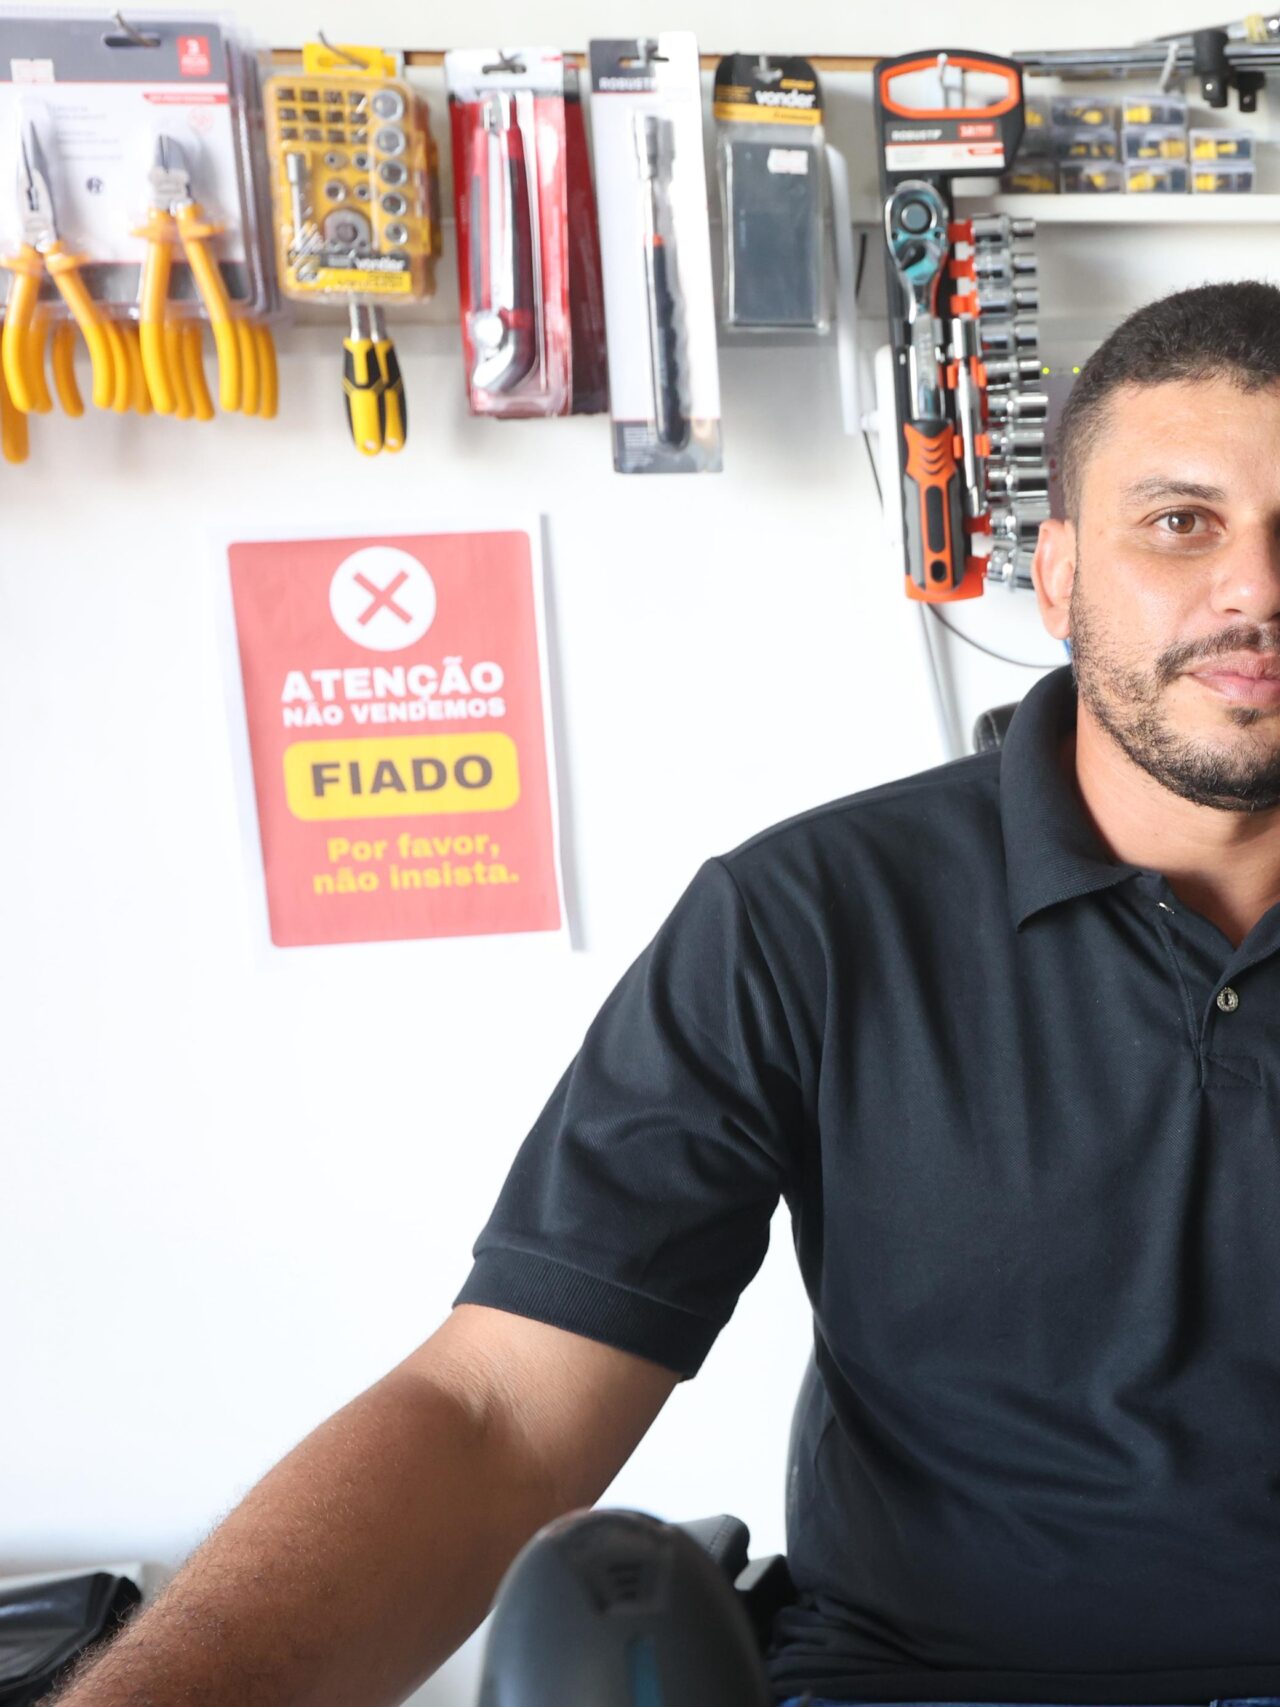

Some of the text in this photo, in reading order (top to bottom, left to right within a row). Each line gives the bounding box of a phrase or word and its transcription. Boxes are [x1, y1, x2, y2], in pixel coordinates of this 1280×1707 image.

[755, 88, 816, 108] vonder
[281, 656, 505, 706] ATENÇÃO
[282, 697, 506, 728] NÃO VENDEMOS
[310, 754, 493, 797] FIADO
[327, 832, 500, 863] Por favor,
[313, 861, 519, 895] não insista.
